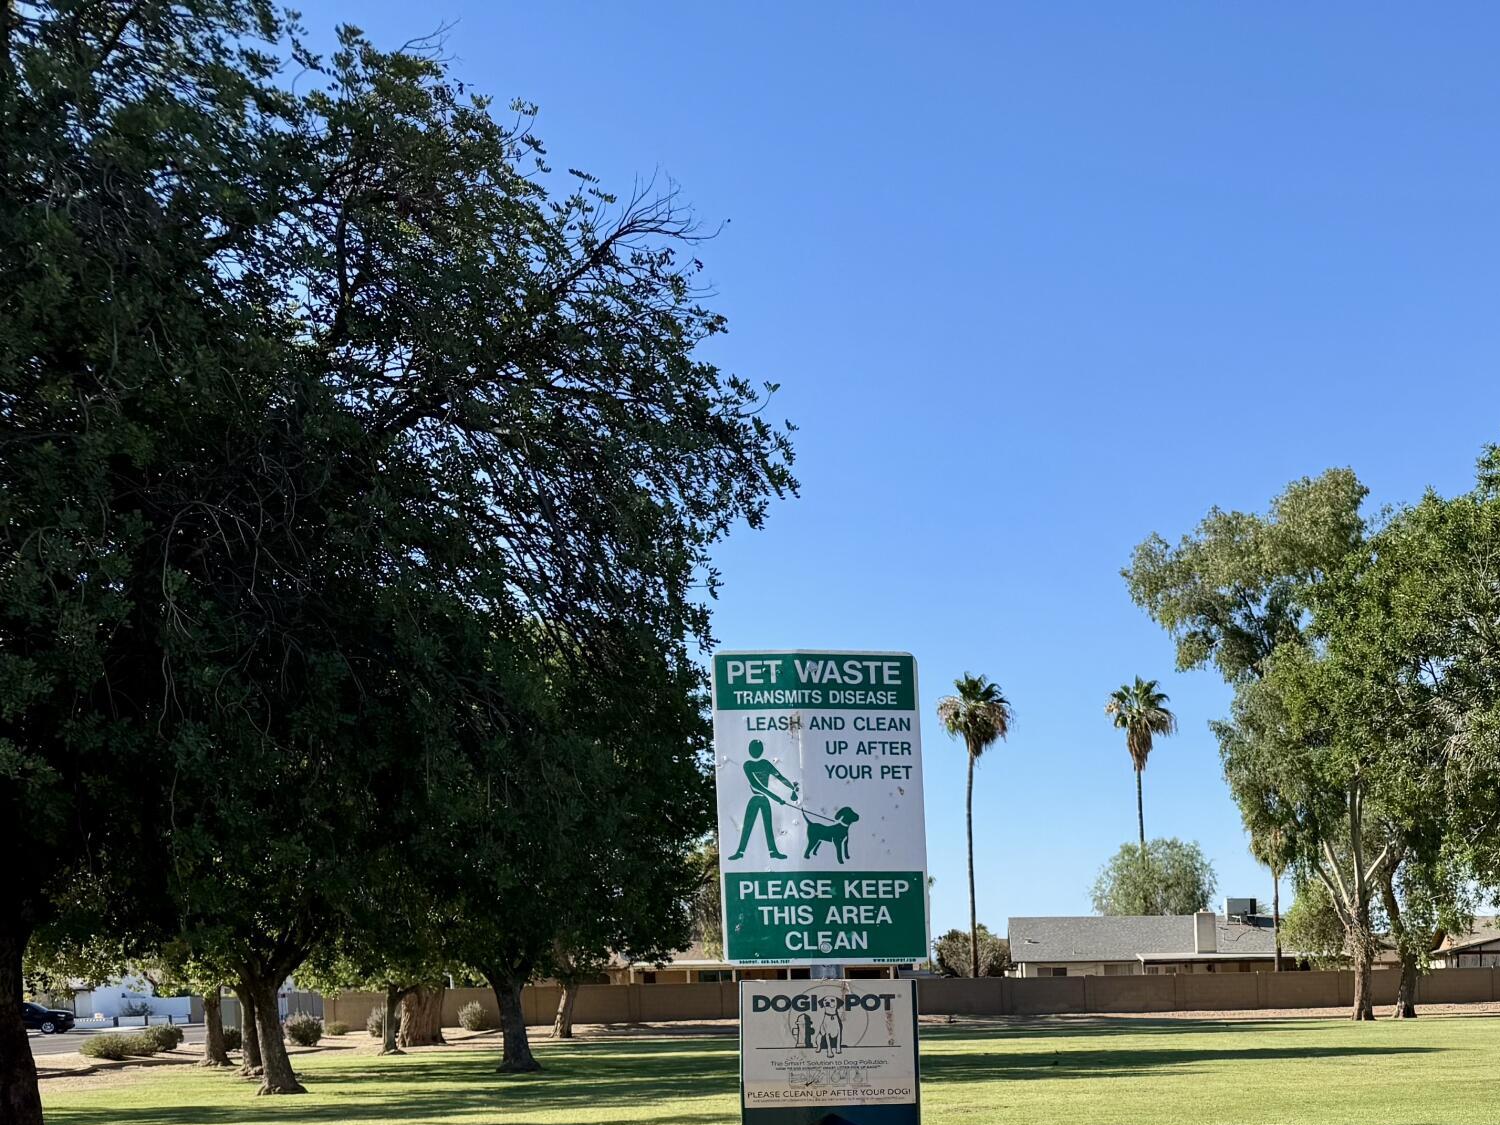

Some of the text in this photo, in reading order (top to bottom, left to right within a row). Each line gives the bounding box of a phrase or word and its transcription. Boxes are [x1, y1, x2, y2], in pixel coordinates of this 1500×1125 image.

[727, 660, 902, 685] PET WASTE
[733, 689, 897, 705] TRANSMITS DISEASE
[746, 716, 911, 732] LEASH AND CLEAN
[825, 741, 912, 756] UP AFTER
[825, 765, 912, 779] YOUR PET
[739, 879, 909, 900] PLEASE KEEP
[758, 905, 893, 926] THIS AREA
[785, 931, 868, 951] CLEAN
[747, 1087, 911, 1099] PLEASE CLEAN UP AFTER YOUR DOG!
